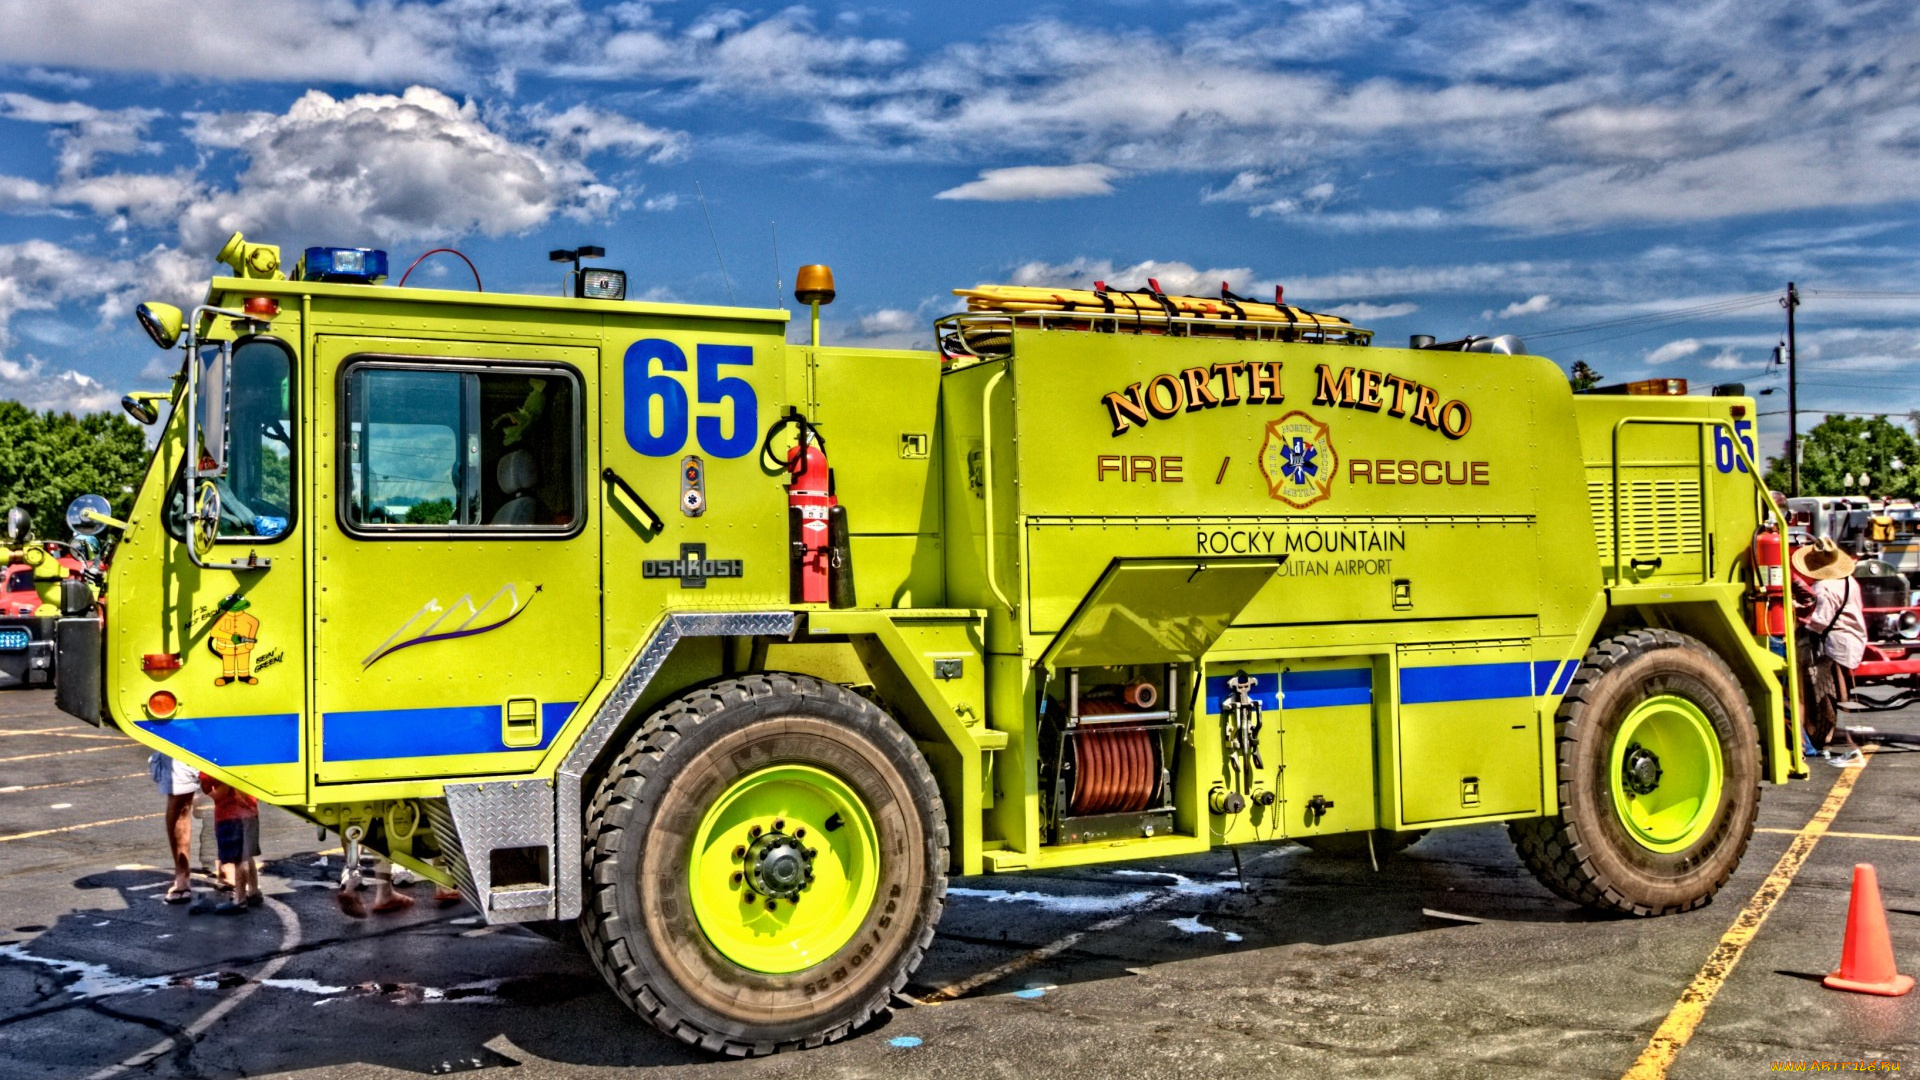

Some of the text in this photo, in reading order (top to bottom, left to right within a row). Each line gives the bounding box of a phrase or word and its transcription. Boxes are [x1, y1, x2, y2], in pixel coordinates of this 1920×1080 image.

[623, 338, 758, 459] 65
[1102, 360, 1473, 440] NORTH METRO
[1097, 454, 1184, 482] FIRE
[1215, 456, 1231, 484] /
[1349, 459, 1490, 485] RESCUE
[1714, 420, 1754, 473] 65
[643, 559, 742, 577] OSHKOSH
[1197, 530, 1406, 554] ROCKY MOUNTAIN
[1334, 558, 1393, 576] AIRPORT
[1666, 676, 1733, 739] MICHELIN
[771, 739, 891, 804] MICHELIN
